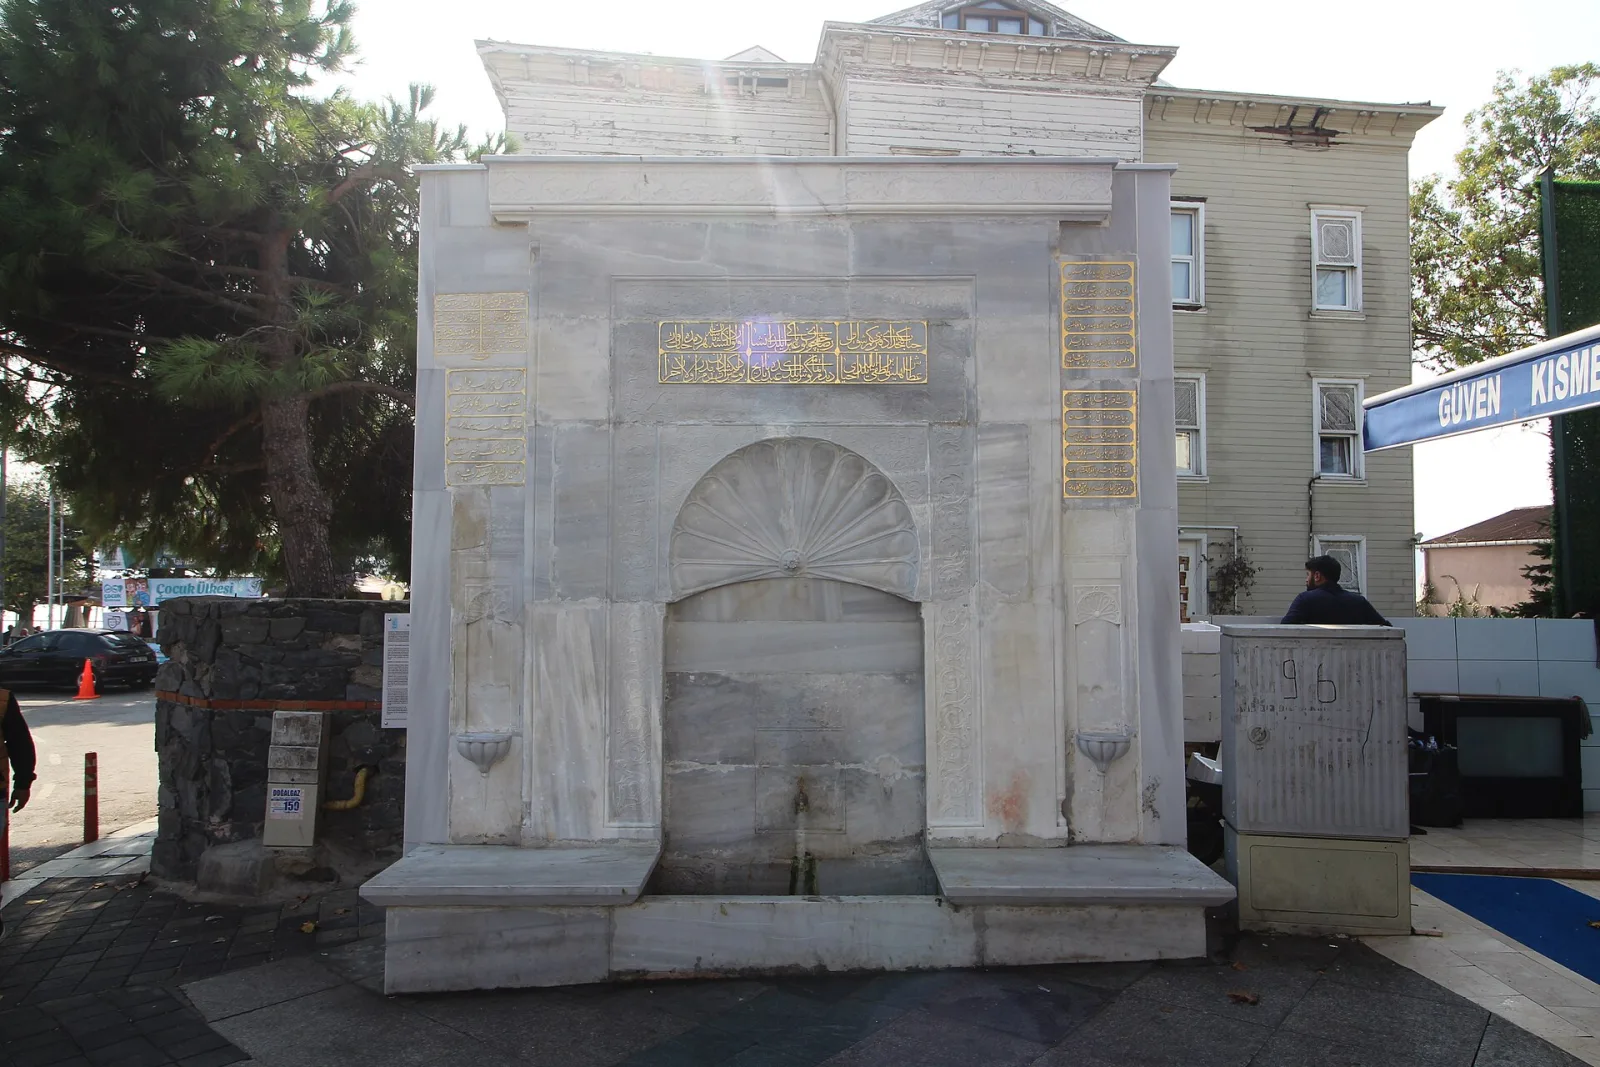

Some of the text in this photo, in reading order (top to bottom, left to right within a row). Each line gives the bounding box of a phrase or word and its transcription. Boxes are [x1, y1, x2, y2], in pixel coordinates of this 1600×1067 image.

[1438, 374, 1501, 428] GÜVEN
[156, 581, 234, 597] Çocuk Ülkesi
[272, 789, 301, 797] DOĞALGAZ
